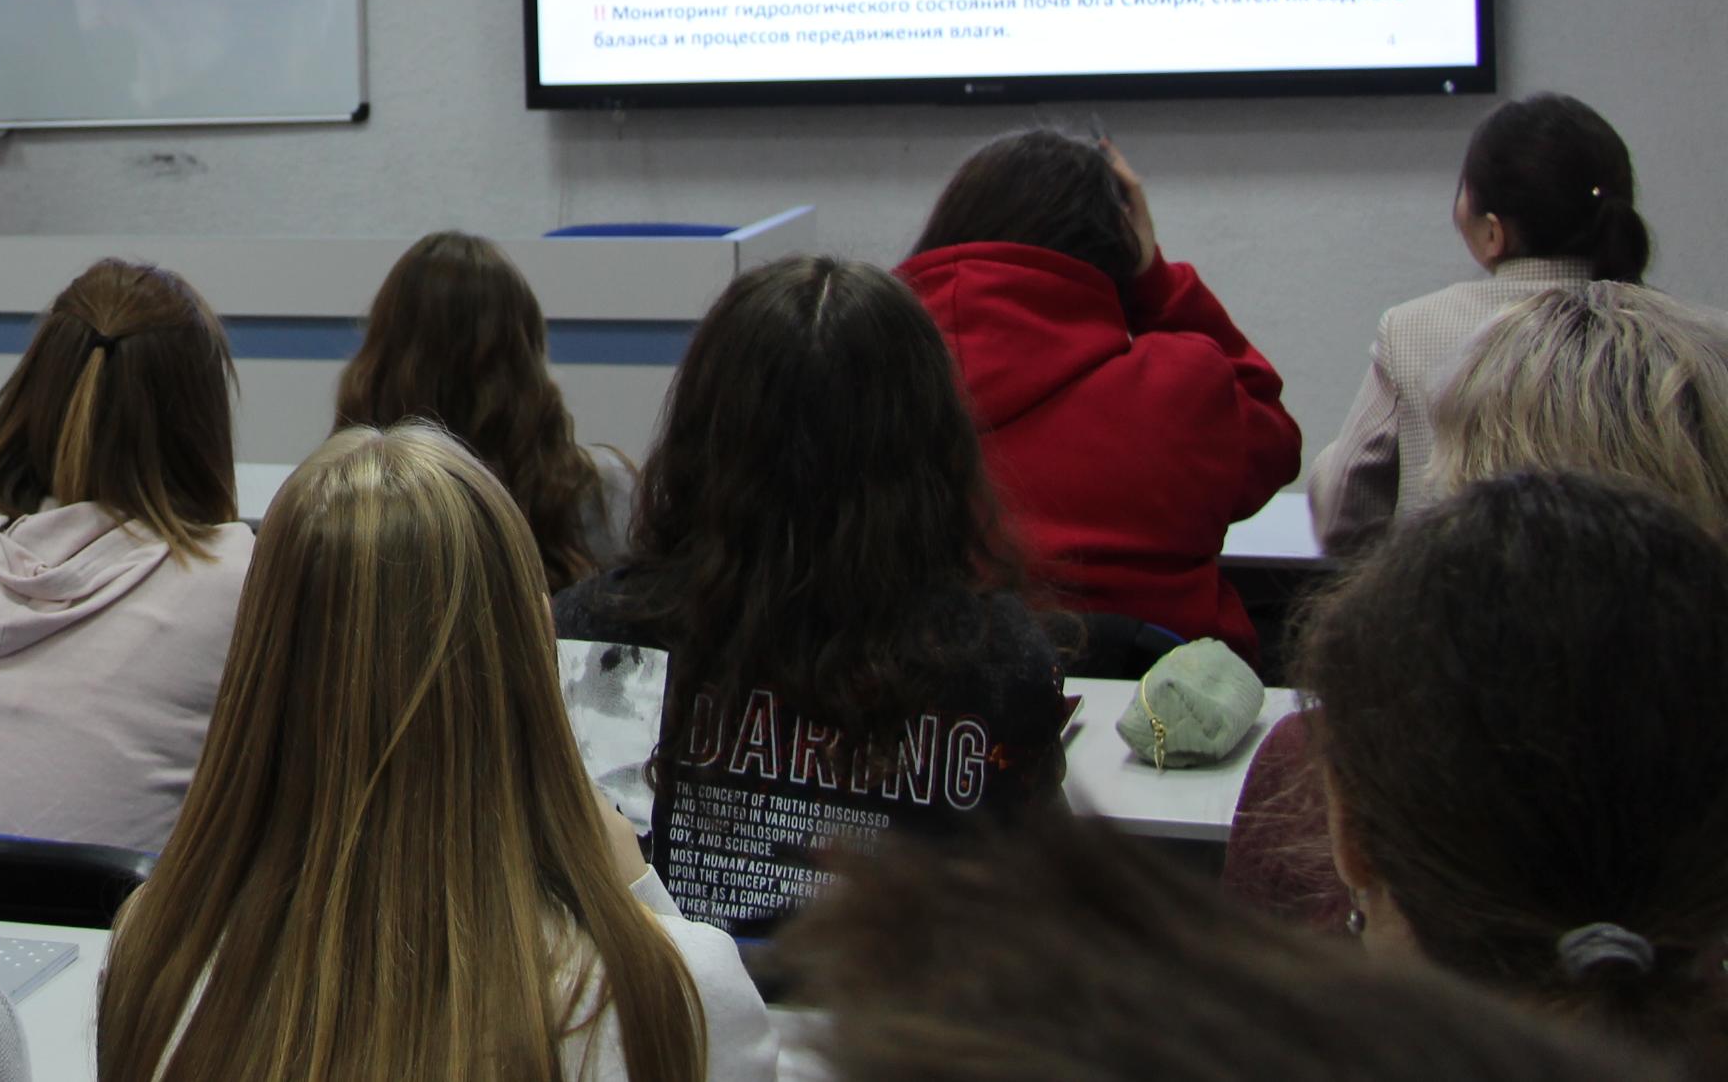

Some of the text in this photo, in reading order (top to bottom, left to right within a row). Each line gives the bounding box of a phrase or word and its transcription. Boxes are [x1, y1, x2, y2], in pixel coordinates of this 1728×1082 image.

[593, 4, 607, 22] !!
[611, 2, 730, 22] Мониторинг
[593, 21, 1011, 49] баланса и процессов передвижения влаги.
[673, 797, 696, 814] AND
[749, 807, 762, 823] IN
[765, 809, 814, 832] VARIOUS
[698, 784, 750, 805] CONCEPT
[751, 792, 767, 808] OF
[769, 795, 807, 816] TRUTH
[809, 802, 821, 818] IS
[824, 804, 890, 829] DISCUSSED
[698, 832, 722, 849] AND
[725, 835, 775, 857] SCIENCE.
[668, 862, 696, 881] UPON
[699, 867, 720, 885] THE
[779, 879, 821, 899] WHERE
[670, 847, 701, 866] MOST
[703, 853, 746, 873] HUMAN
[748, 859, 813, 884] ACTIVITIES
[667, 878, 709, 899] NATURE
[711, 886, 727, 901] AS
[729, 888, 737, 903] A
[739, 889, 792, 911] CONCEPT
[711, 900, 739, 918] THAN
